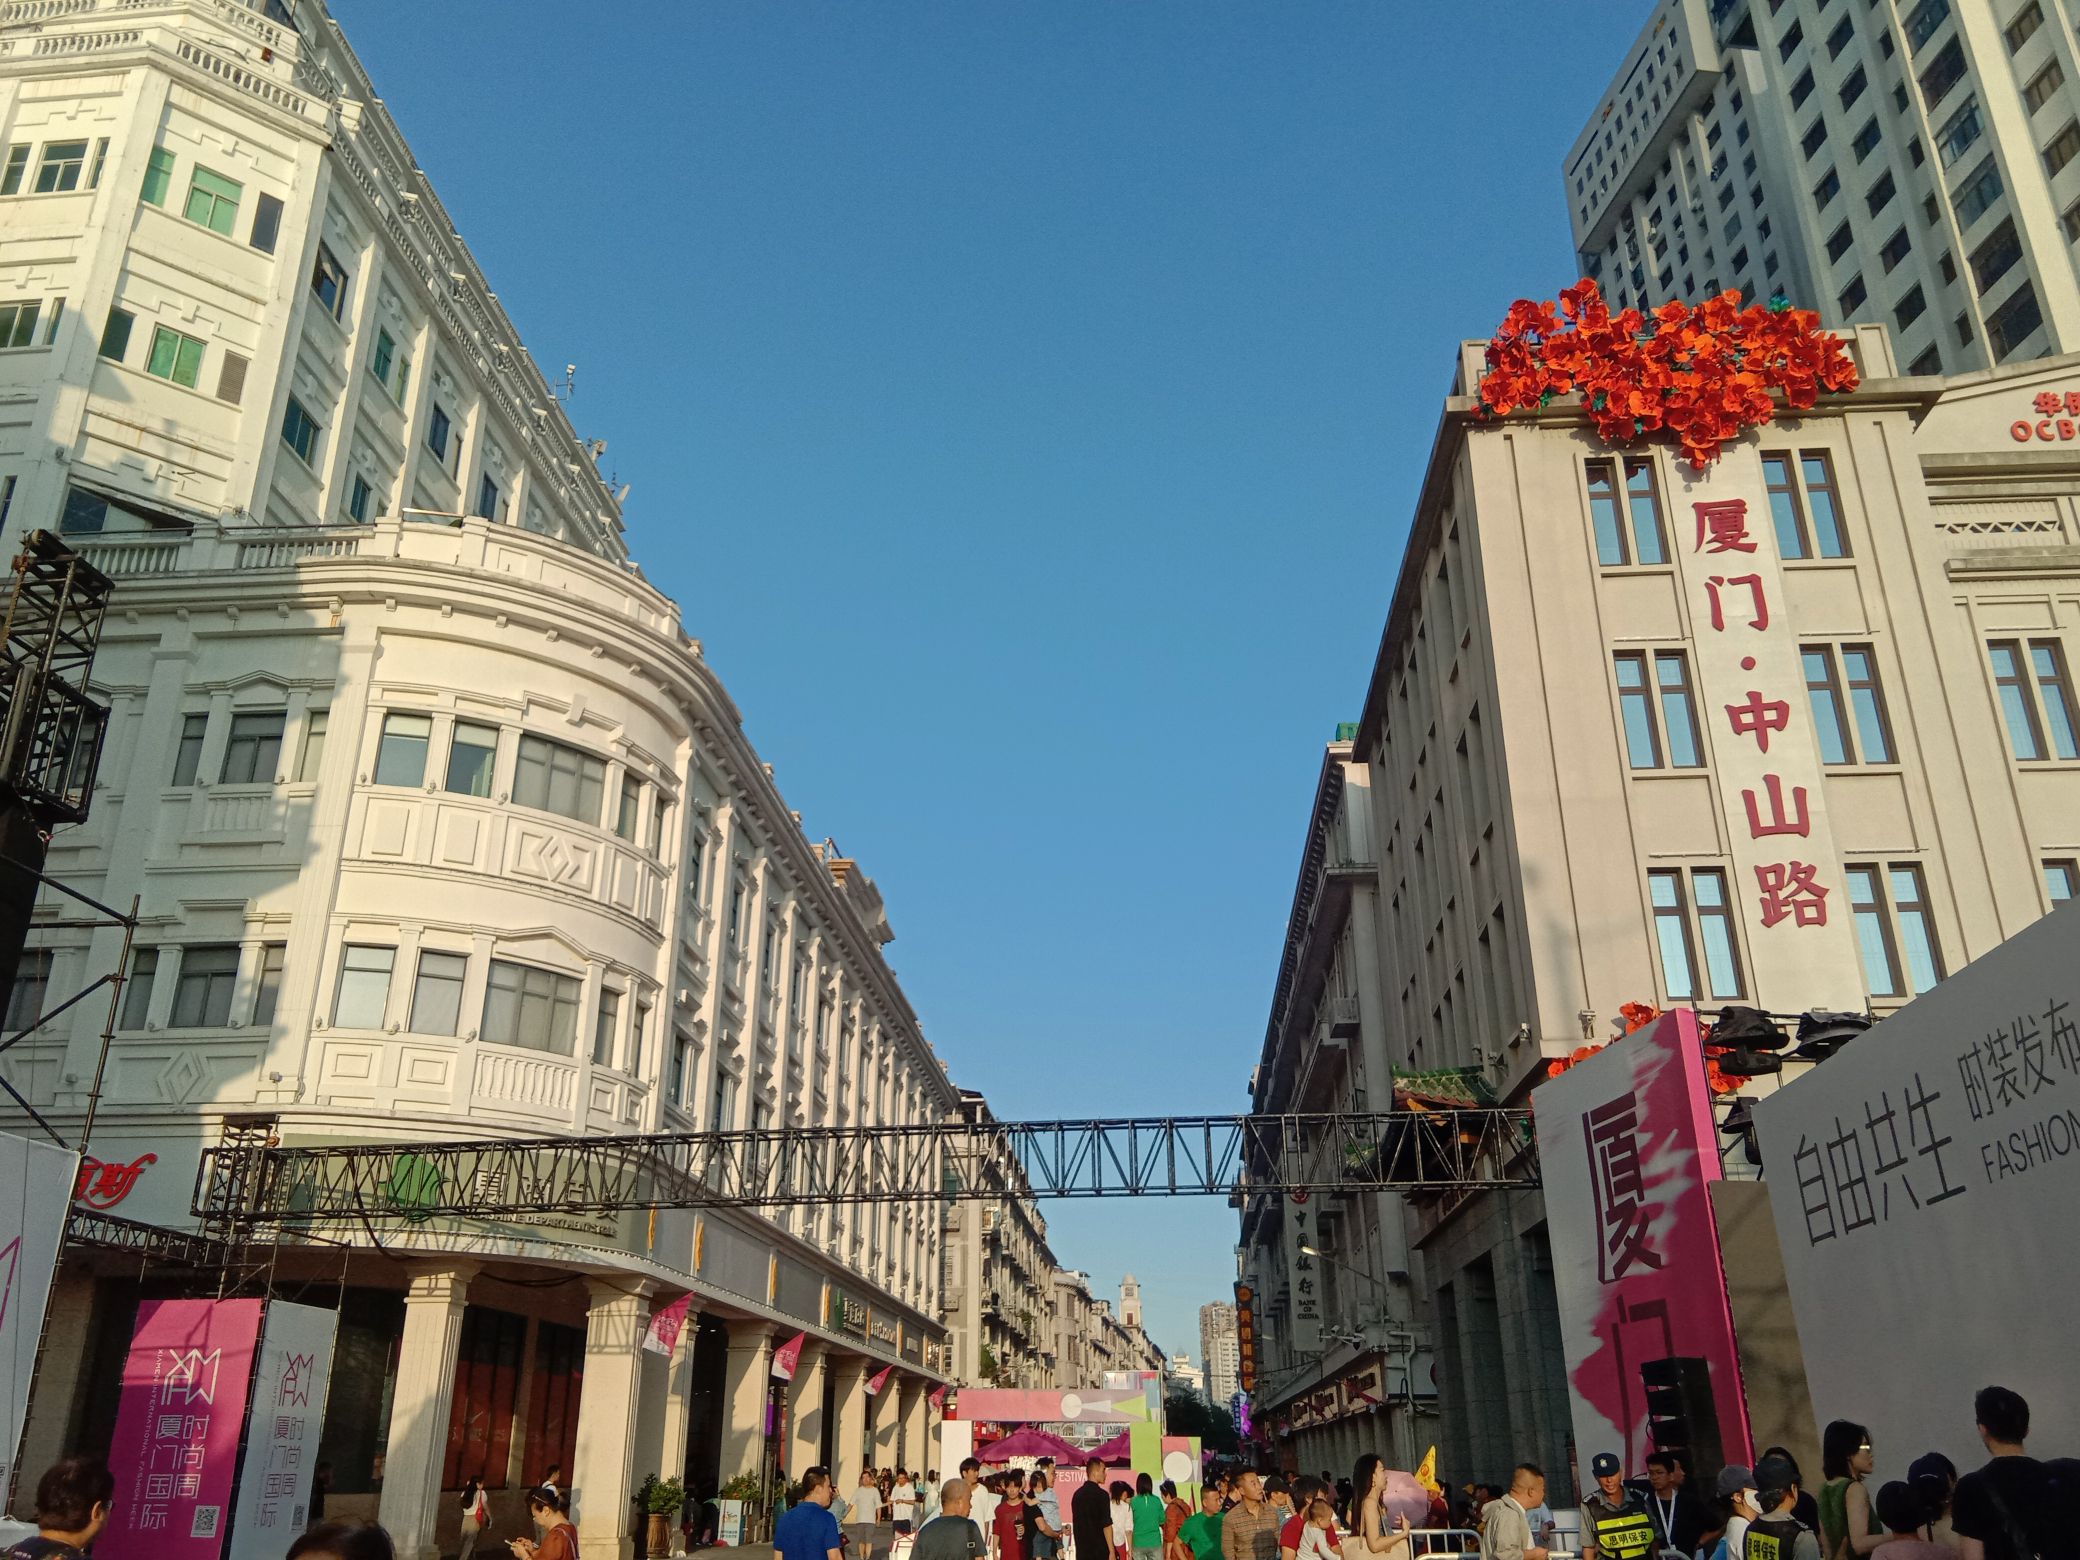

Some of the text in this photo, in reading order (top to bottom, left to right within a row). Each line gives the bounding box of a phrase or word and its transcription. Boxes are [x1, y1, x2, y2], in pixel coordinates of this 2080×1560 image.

[2010, 420, 2080, 442] OCB
[1792, 1072, 1967, 1248] 自由共生
[140, 1414, 183, 1530] 厦门国际
[173, 1414, 210, 1499] 时尚周
[1055, 1471, 1088, 1482] FESTIVA
[1608, 1531, 1648, 1546] 思明保安
